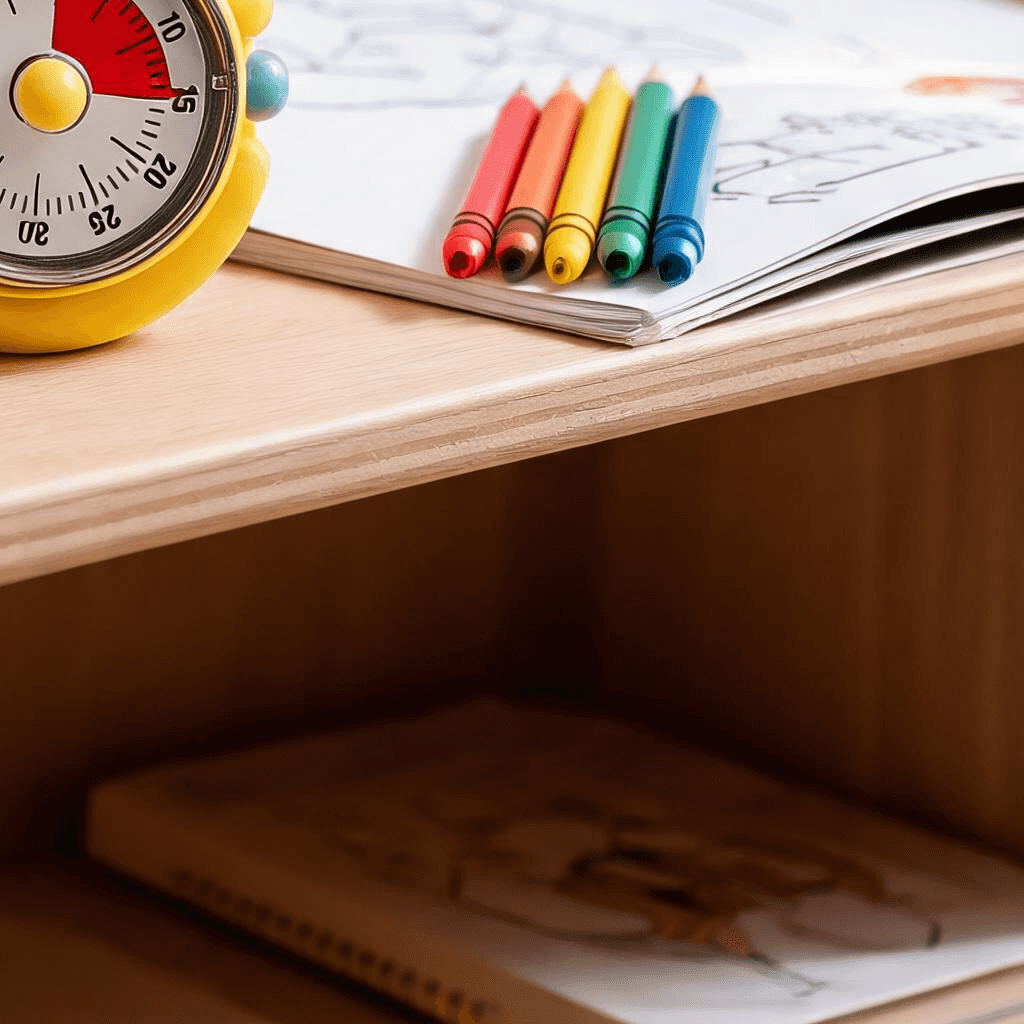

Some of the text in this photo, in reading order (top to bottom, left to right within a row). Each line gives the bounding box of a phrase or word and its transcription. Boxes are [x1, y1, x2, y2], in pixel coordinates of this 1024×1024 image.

[157, 11, 186, 43] 10
[171, 84, 199, 114] 15
[143, 153, 177, 189] 20
